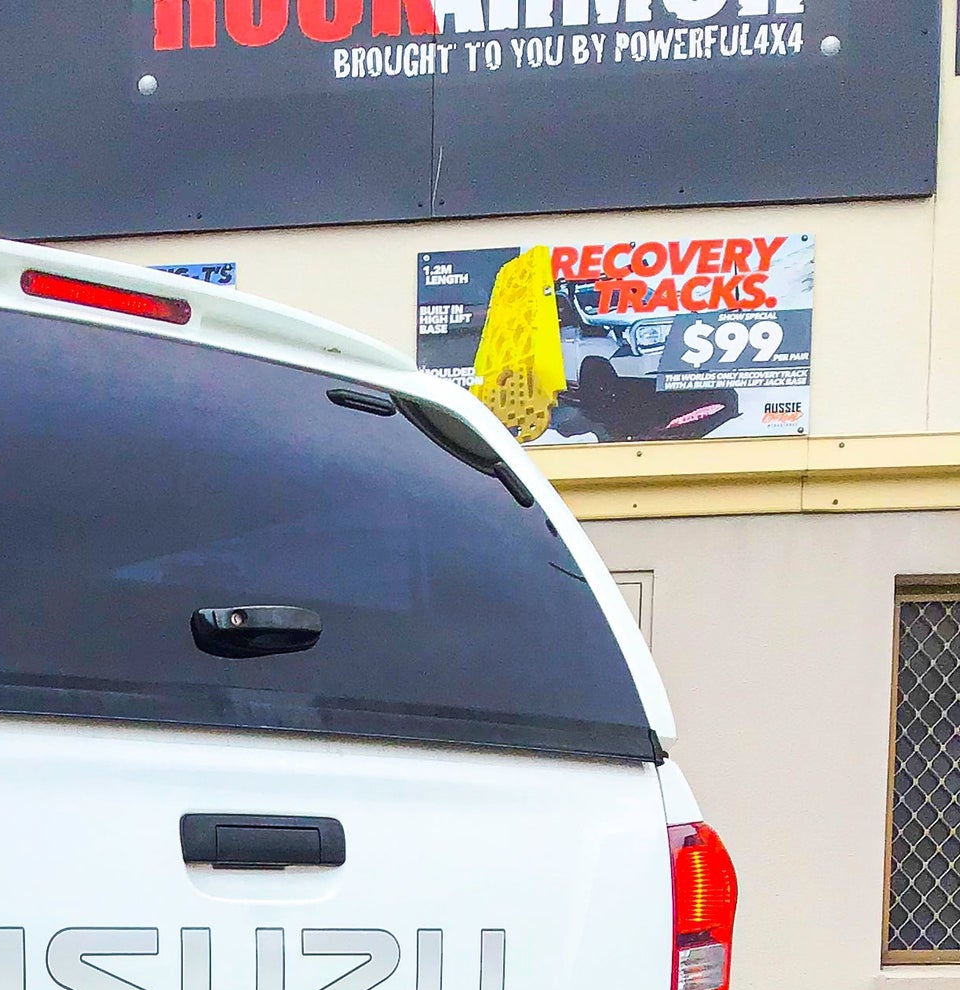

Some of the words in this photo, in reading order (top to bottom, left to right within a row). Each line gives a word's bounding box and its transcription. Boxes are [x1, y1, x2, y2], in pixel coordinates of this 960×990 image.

[333, 43, 457, 78] BROUGHT
[465, 41, 503, 72] TO
[511, 35, 565, 68] YOU
[572, 33, 607, 65] BY
[614, 22, 804, 62] POWERFUL4X4
[551, 236, 788, 280] RECOVERY
[423, 264, 453, 276] 1.2M
[425, 273, 469, 285] LENGTH
[594, 272, 778, 315] TRACKS.
[420, 305, 450, 315] BUILT
[451, 304, 464, 314] IN
[420, 314, 448, 325] HIGH
[450, 313, 473, 324] LIFT
[718, 312, 745, 321] SHOW
[744, 311, 778, 321] SPECIAL
[419, 324, 448, 335] BASE
[680, 319, 783, 369] $99
[665, 374, 682, 382] THE
[681, 373, 716, 381] WORLDS
[716, 371, 739, 380] ONLY
[764, 402, 802, 413] AUSSIE
